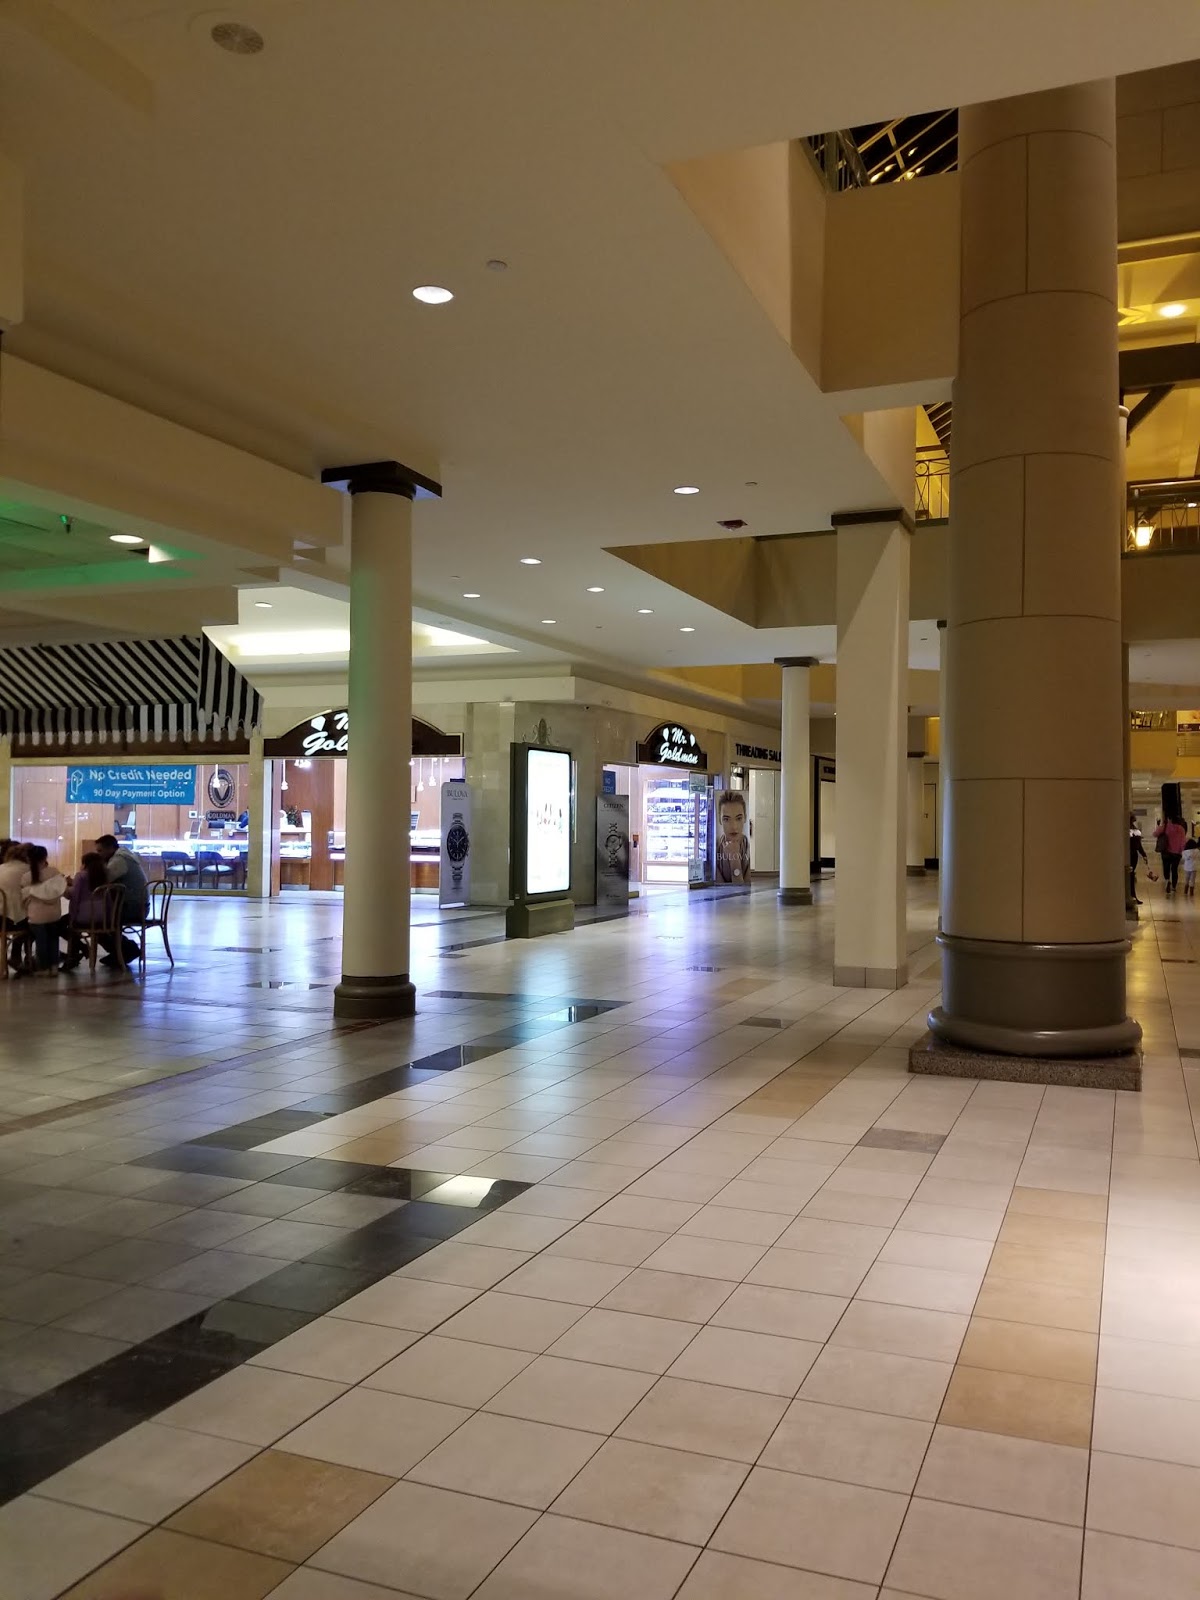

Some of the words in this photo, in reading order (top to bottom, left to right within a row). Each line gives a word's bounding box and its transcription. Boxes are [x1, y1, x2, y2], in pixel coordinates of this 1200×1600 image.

[672, 727, 688, 744] Mr.
[658, 742, 698, 764] Goldman
[735, 743, 769, 760] THREADING
[89, 769, 105, 780] No
[107, 769, 144, 780] Credit
[147, 768, 192, 780] Needed
[93, 789, 103, 797] 90
[104, 789, 120, 798] Day
[121, 789, 156, 798] Payment
[157, 789, 186, 798] Option
